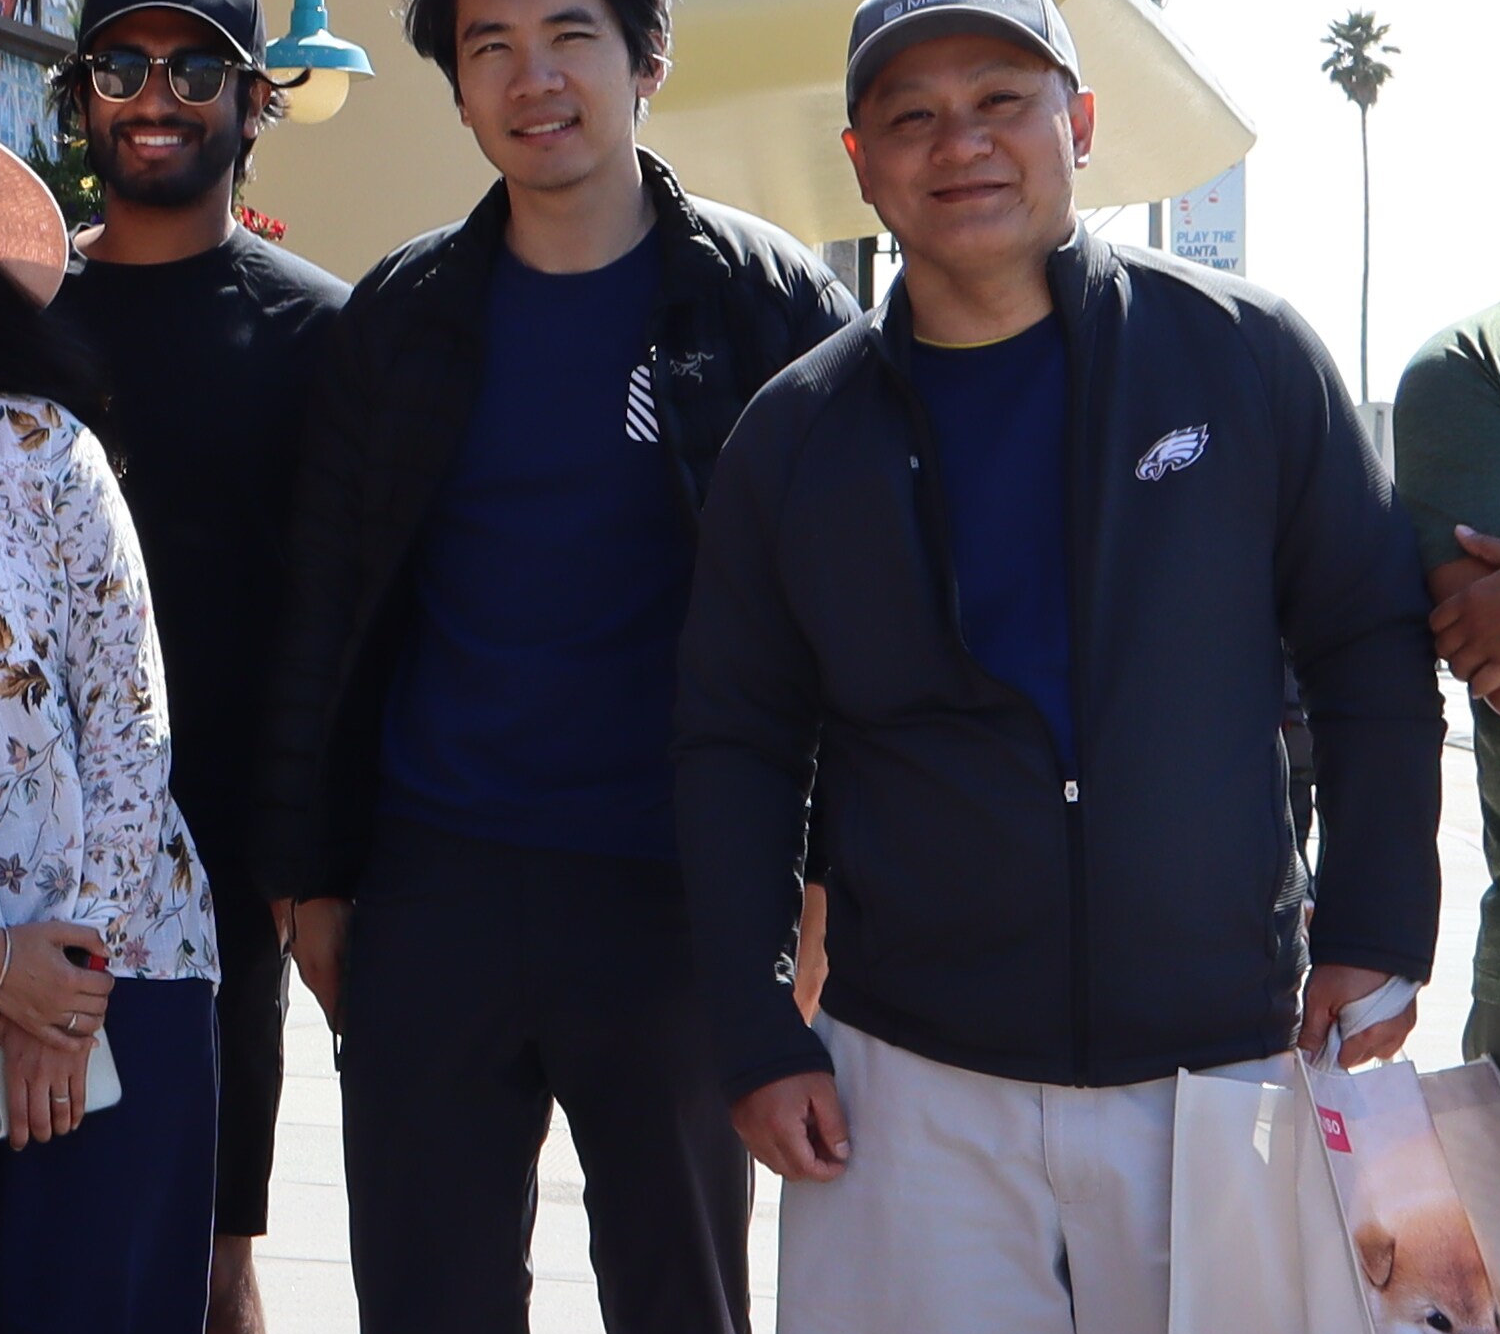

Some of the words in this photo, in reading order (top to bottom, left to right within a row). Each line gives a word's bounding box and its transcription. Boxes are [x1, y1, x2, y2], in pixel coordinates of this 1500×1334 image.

[1176, 230, 1210, 243] PLAY
[1211, 230, 1237, 243] THE
[1176, 245, 1218, 257] SANTA
[1211, 257, 1239, 269] WAY
